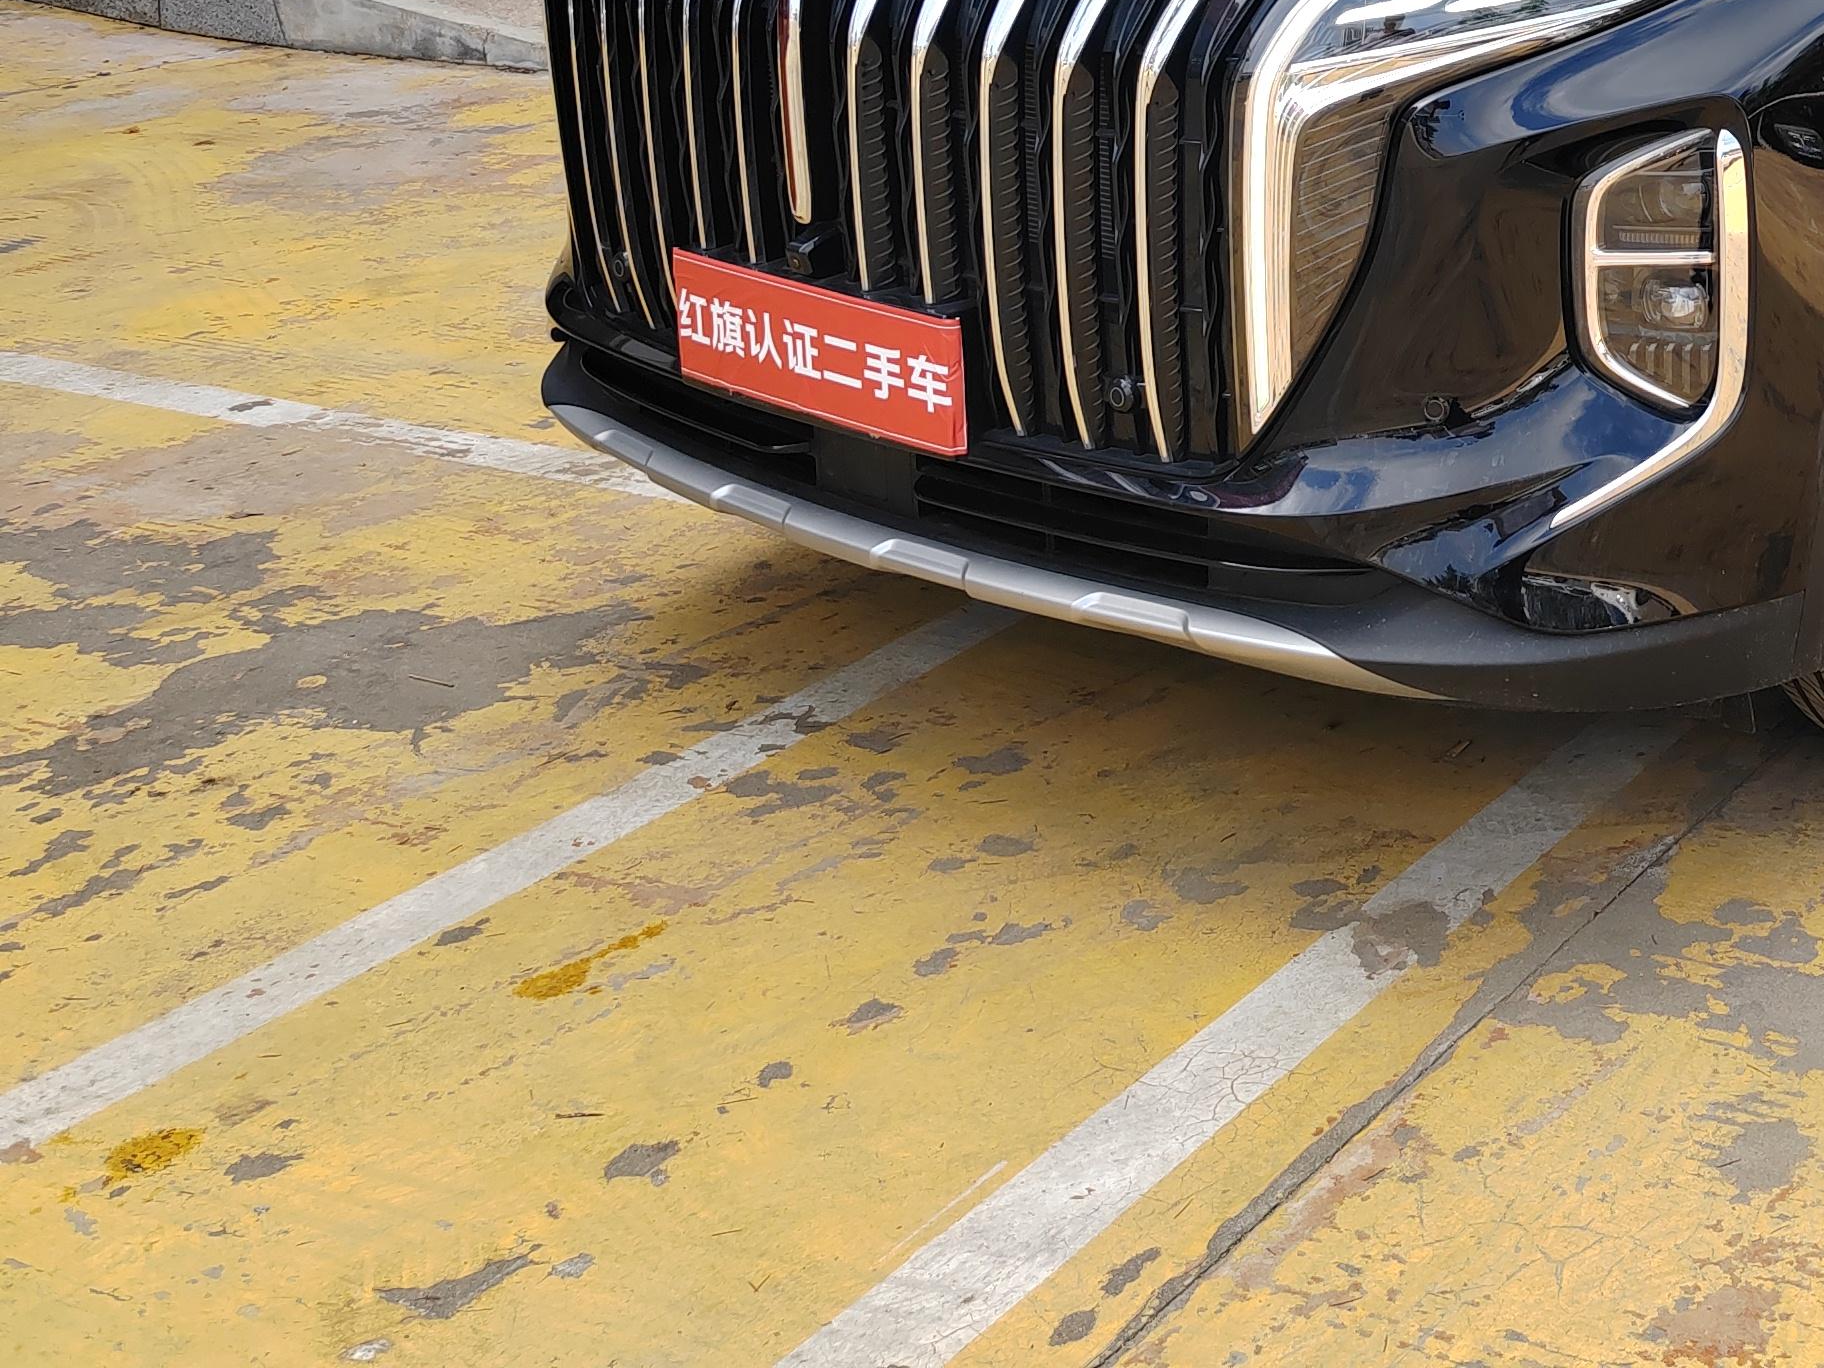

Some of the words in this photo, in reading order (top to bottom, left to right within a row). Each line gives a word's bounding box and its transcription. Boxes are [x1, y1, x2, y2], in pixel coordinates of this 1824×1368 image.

[678, 287, 953, 414] 红旗认证二手车
